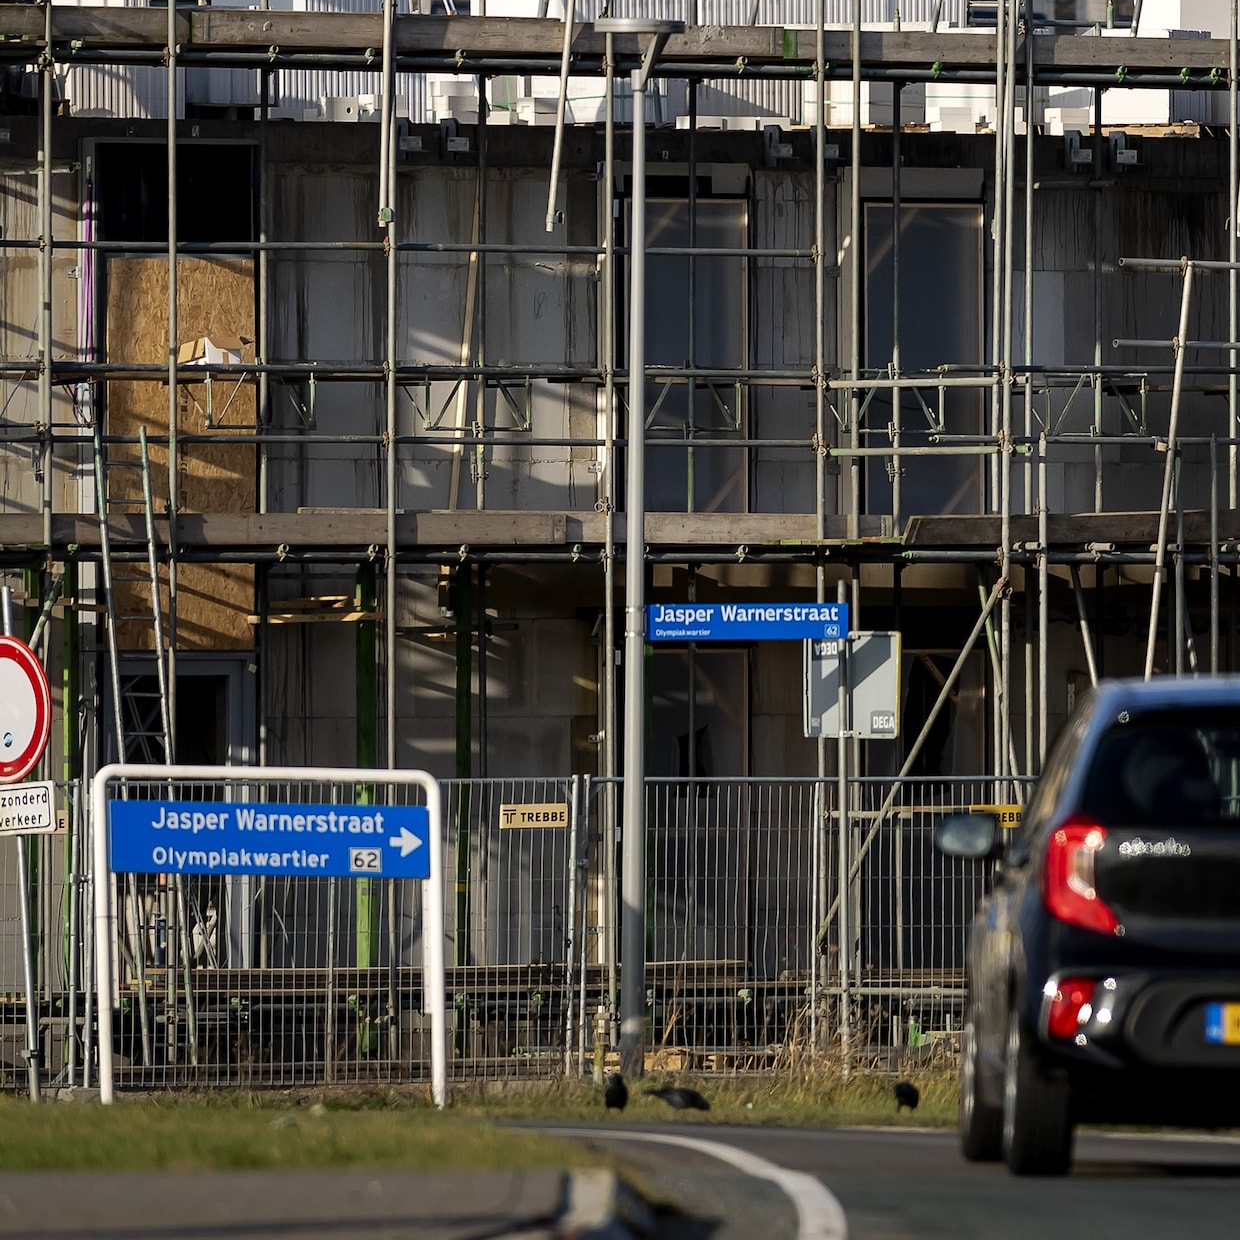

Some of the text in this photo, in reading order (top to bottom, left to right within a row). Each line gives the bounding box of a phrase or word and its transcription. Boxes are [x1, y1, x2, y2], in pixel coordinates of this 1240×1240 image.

[655, 605, 839, 625] Jasper Warnerstraat
[655, 626, 838, 637] Olympiakwartier 62
[872, 716, 895, 729] DEGA
[1, 791, 47, 807] zonderd
[0, 813, 42, 828] verkeer
[152, 807, 384, 833] Jasper Warnerstraat
[521, 812, 565, 822] TREBBE
[995, 812, 1022, 823] REBB
[152, 847, 378, 868] Olympiakwartier 62
